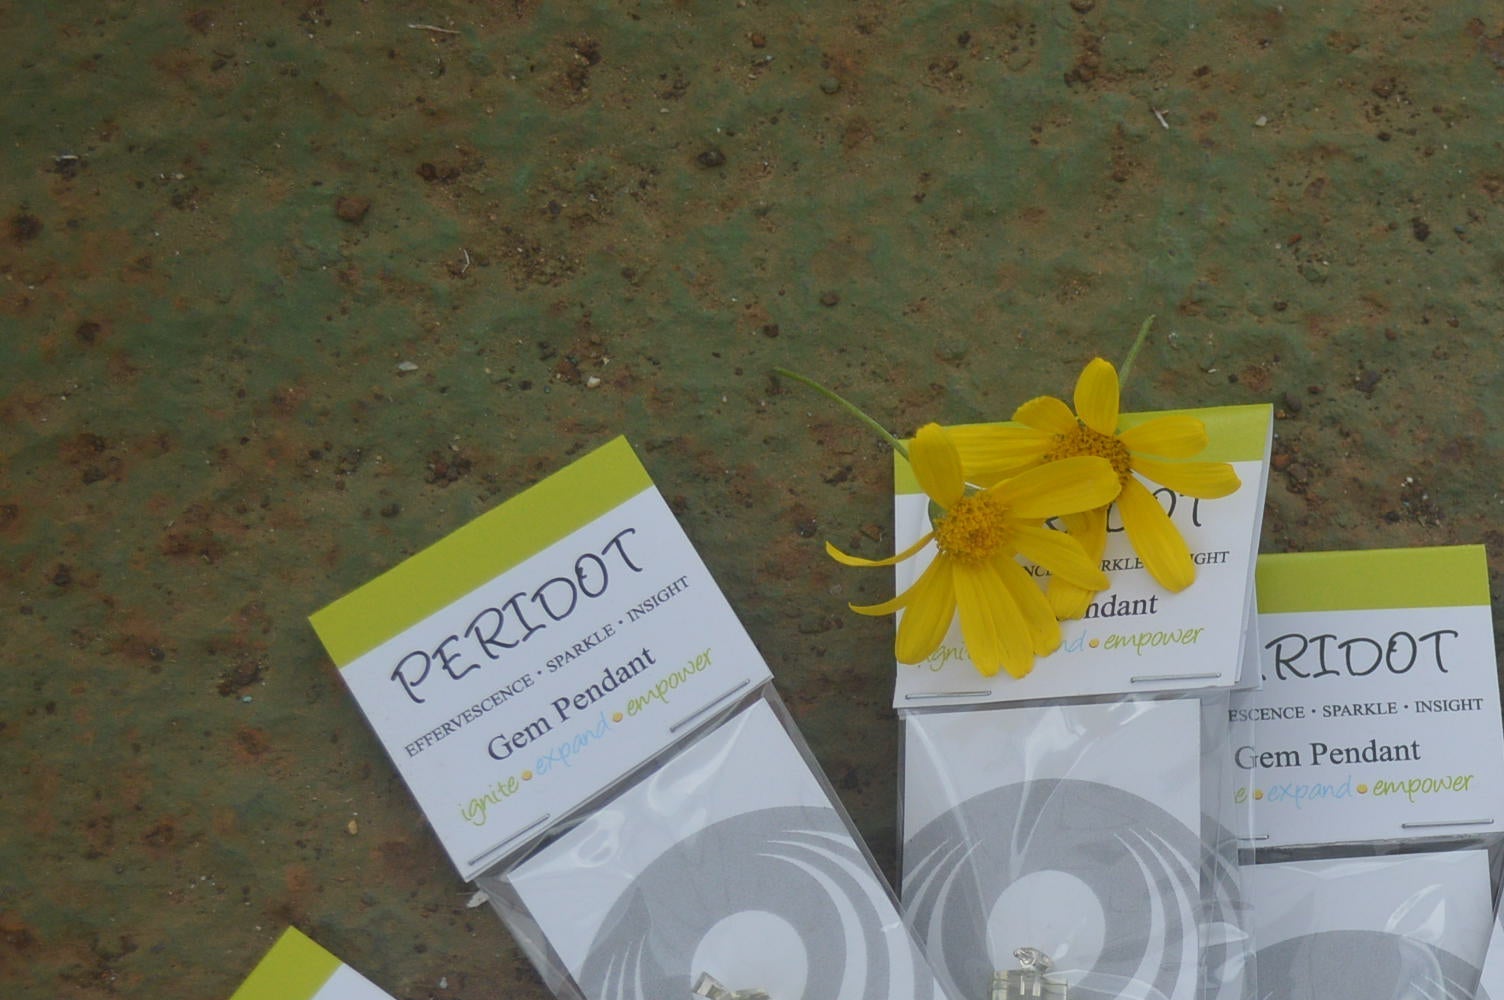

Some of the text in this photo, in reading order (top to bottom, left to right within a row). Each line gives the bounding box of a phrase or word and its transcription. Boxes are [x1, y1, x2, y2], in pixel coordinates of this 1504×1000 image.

[1101, 557, 1143, 573] RKLE
[390, 527, 644, 703] PERIDOT
[1084, 595, 1159, 619] ndant
[1104, 627, 1204, 655] empower
[1261, 630, 1458, 680] RIDOT
[404, 575, 690, 758] EFFERVESCENCE SPARKLE INSIGHT
[486, 646, 657, 762] Gem Pendant
[1228, 698, 1483, 722] ESCENCE SPARKLE INSIGHT
[460, 648, 714, 826] ignite expand empower
[1234, 739, 1422, 770] Gem Pendant
[1266, 774, 1354, 810] expand
[1372, 773, 1474, 802] empower
